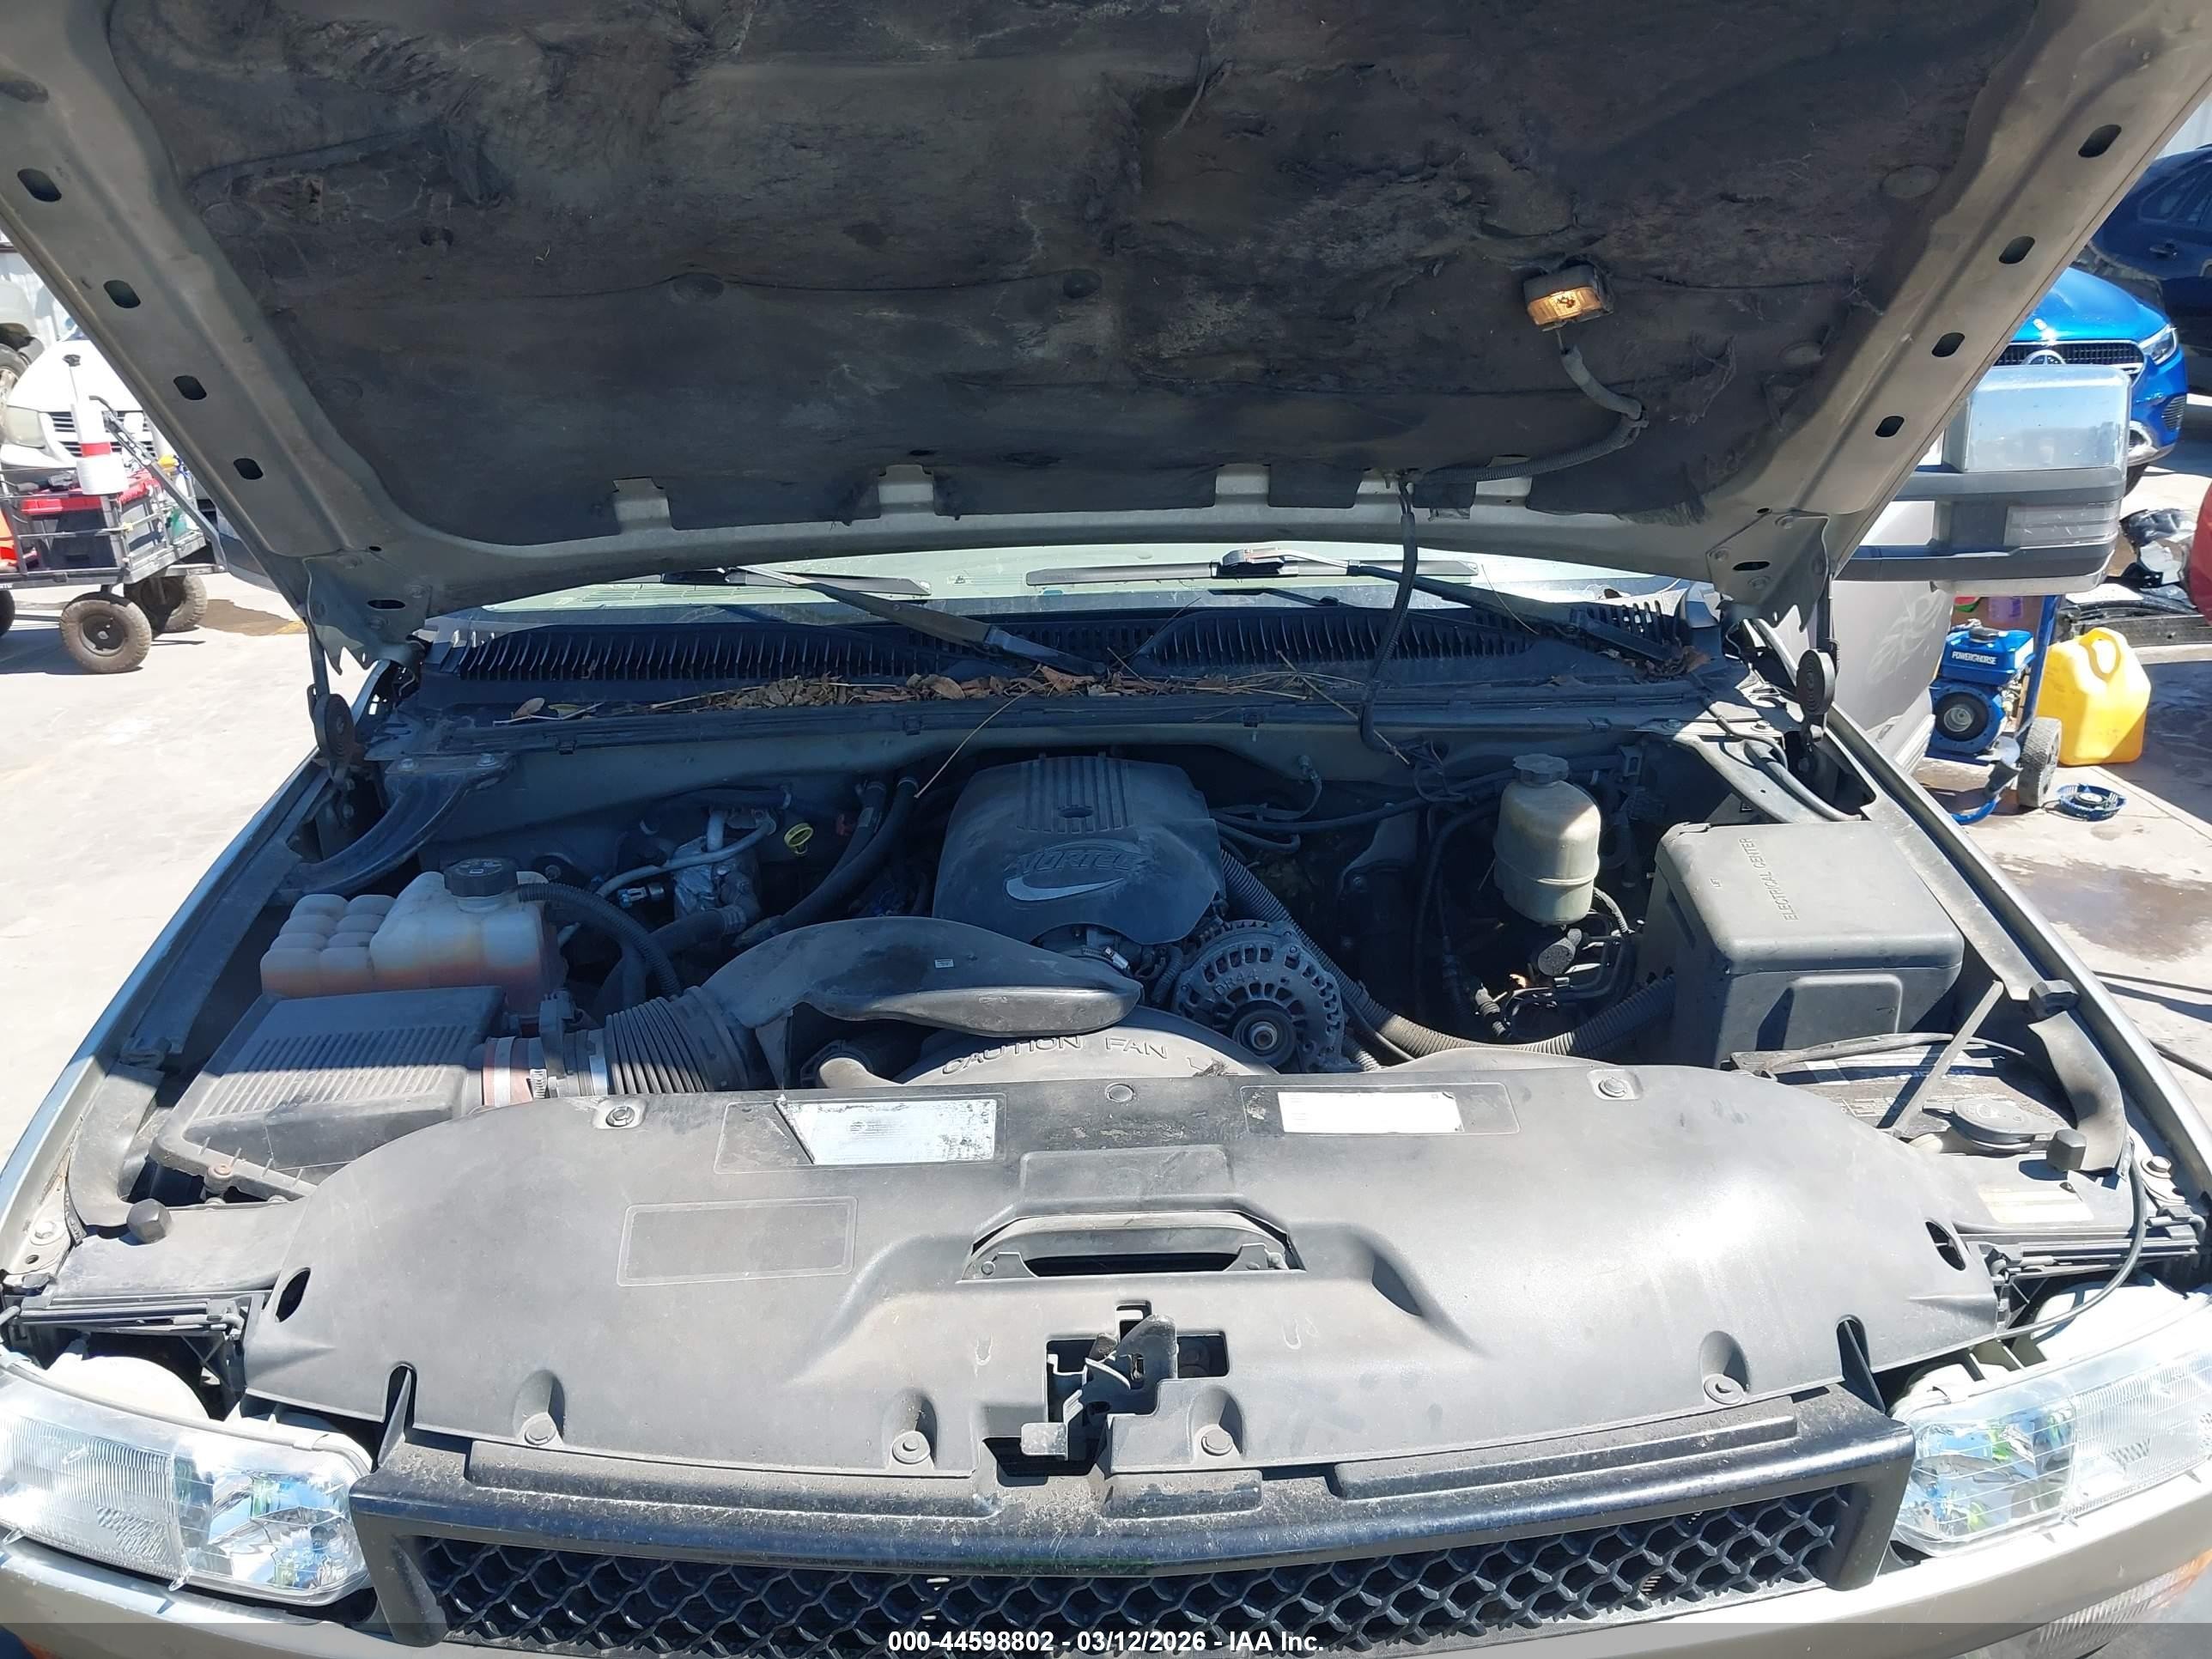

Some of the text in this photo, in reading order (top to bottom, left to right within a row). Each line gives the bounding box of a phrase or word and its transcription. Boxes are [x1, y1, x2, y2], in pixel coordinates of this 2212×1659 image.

[1738, 837, 1799, 921] ELECTRICAL CENTER
[1104, 1036, 1168, 1060] FAN
